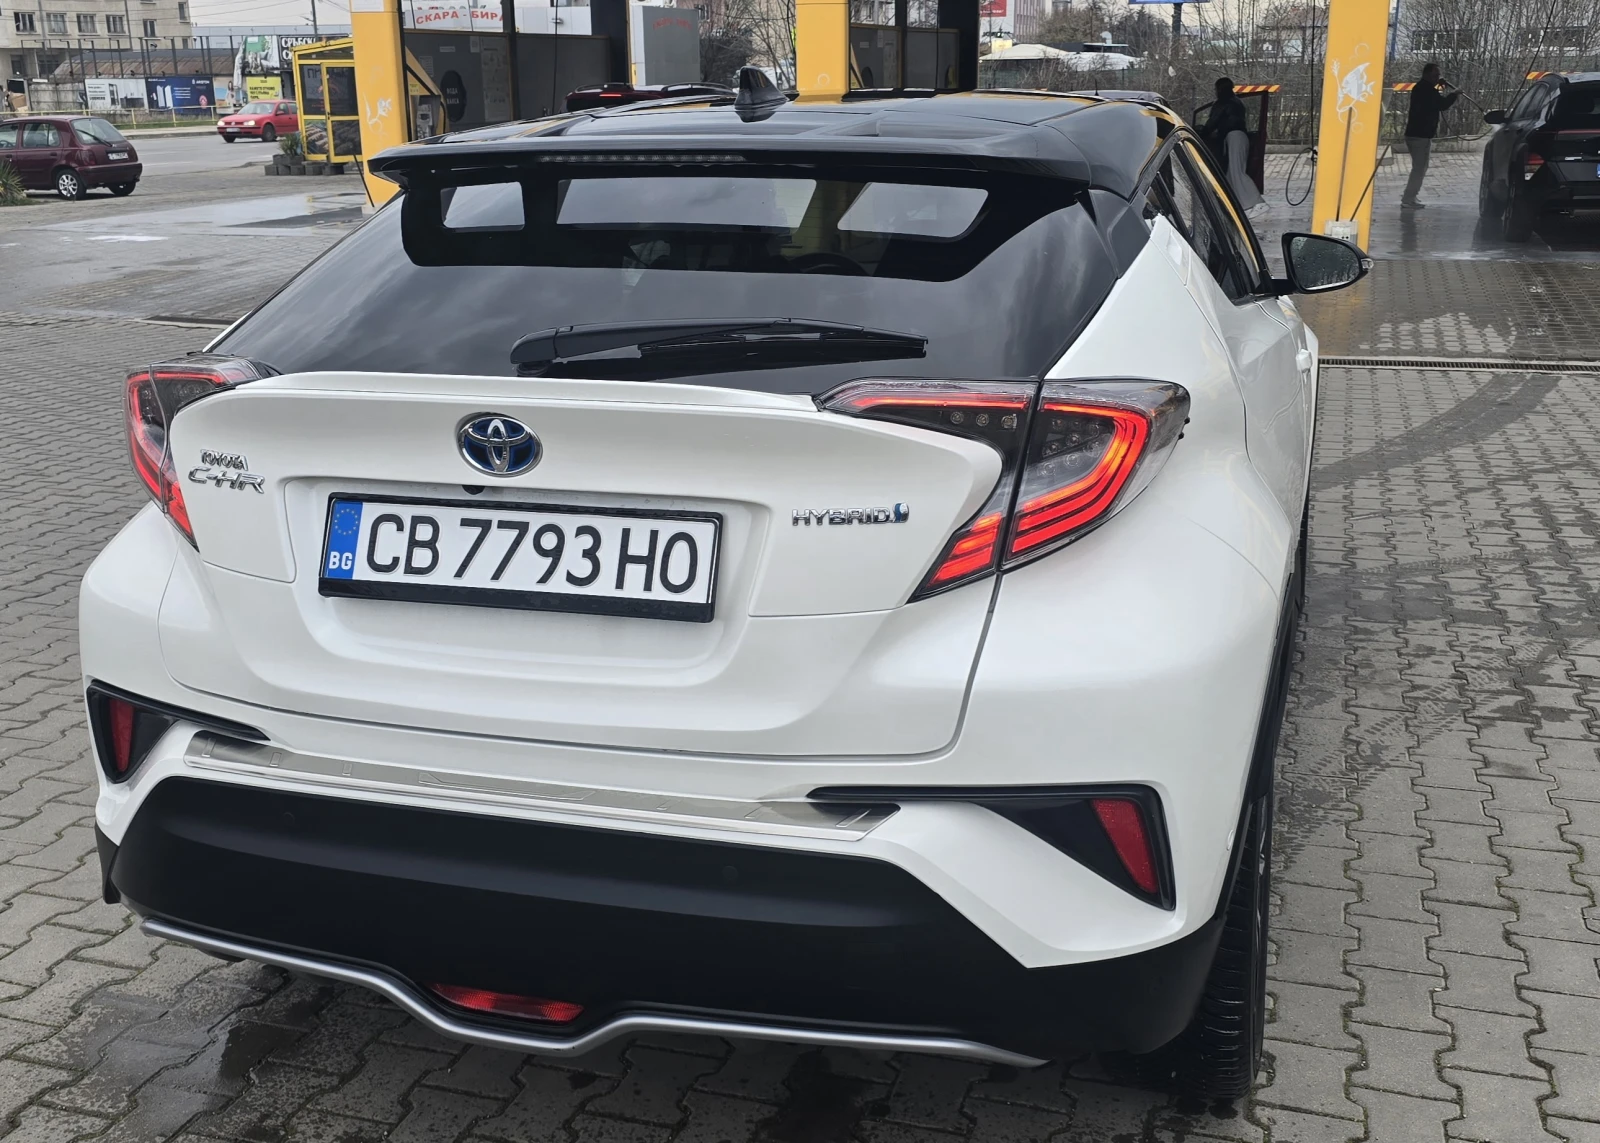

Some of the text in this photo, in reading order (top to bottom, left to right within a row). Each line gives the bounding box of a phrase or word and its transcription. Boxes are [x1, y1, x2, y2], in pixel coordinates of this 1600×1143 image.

[416, 10, 459, 25] СКАРА
[199, 448, 249, 472] TOYOTA
[188, 466, 266, 494] C-HR
[791, 507, 890, 526] HYBRID
[329, 551, 353, 571] BG
[366, 513, 441, 576] CB
[453, 517, 602, 588] 7793
